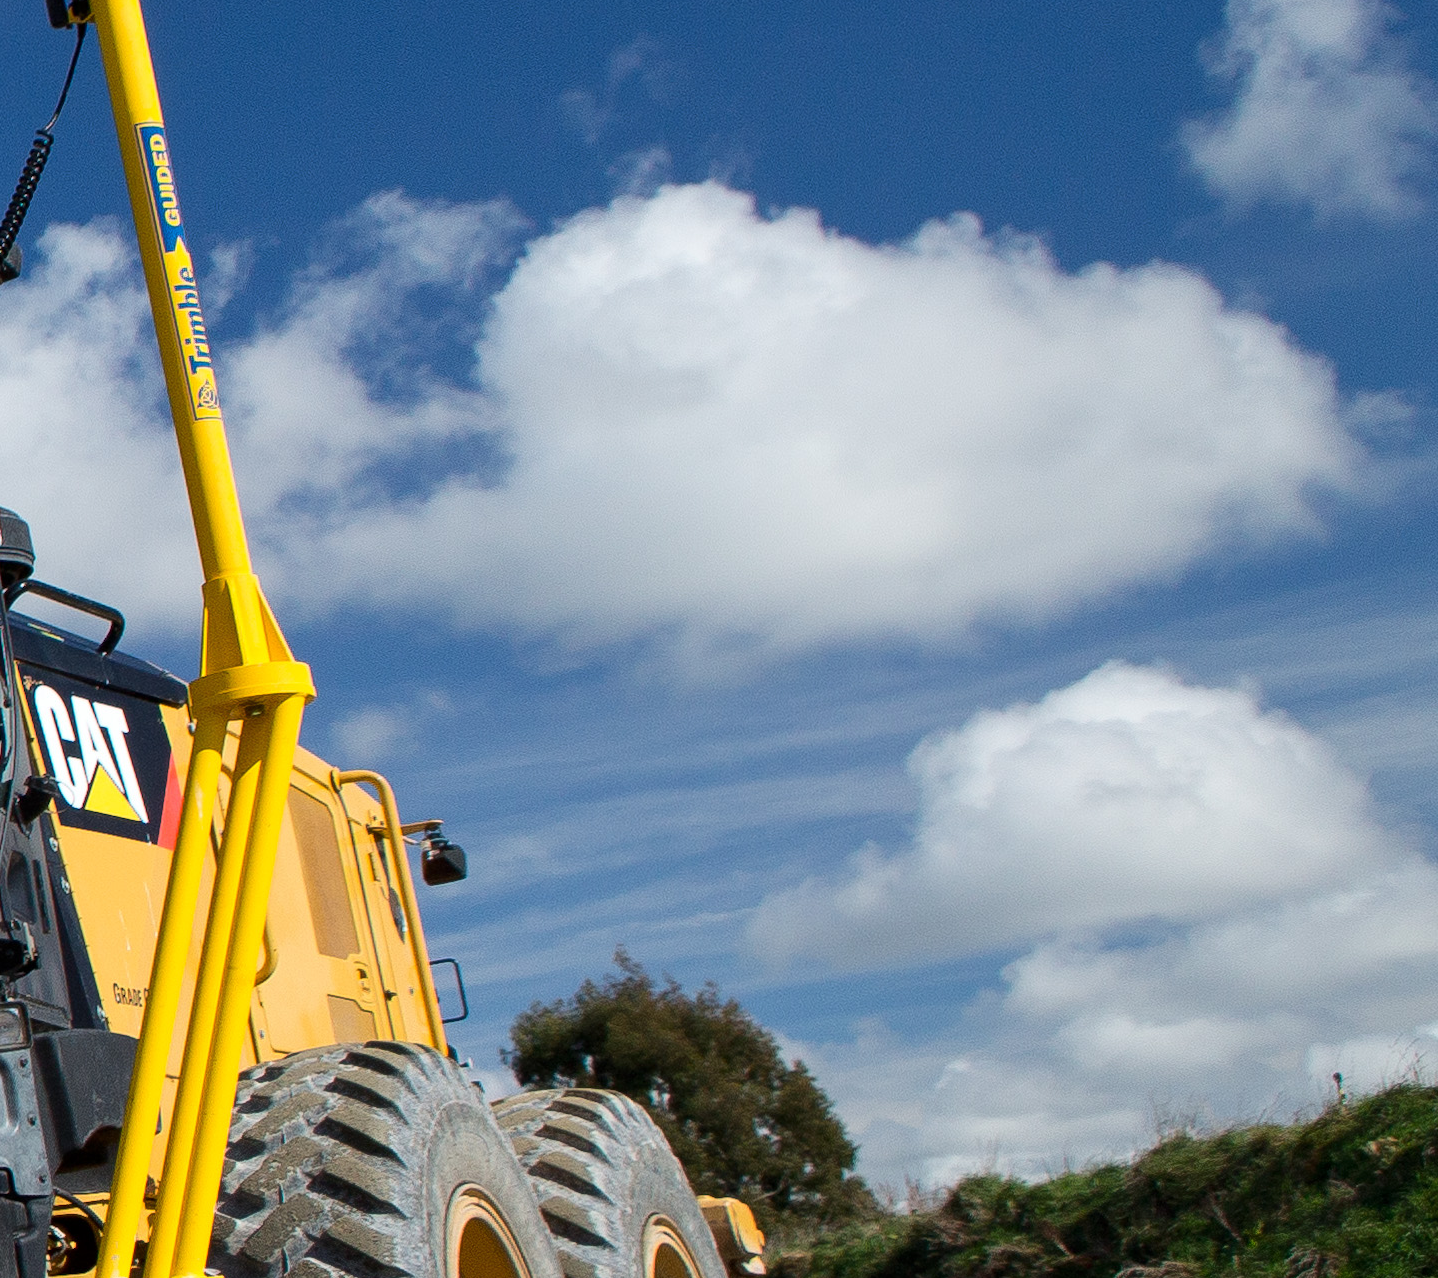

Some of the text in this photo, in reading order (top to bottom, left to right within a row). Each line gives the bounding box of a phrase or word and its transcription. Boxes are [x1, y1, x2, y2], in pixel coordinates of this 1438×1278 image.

[149, 133, 214, 375] Trimble GUIDED
[34, 685, 150, 824] CAT
